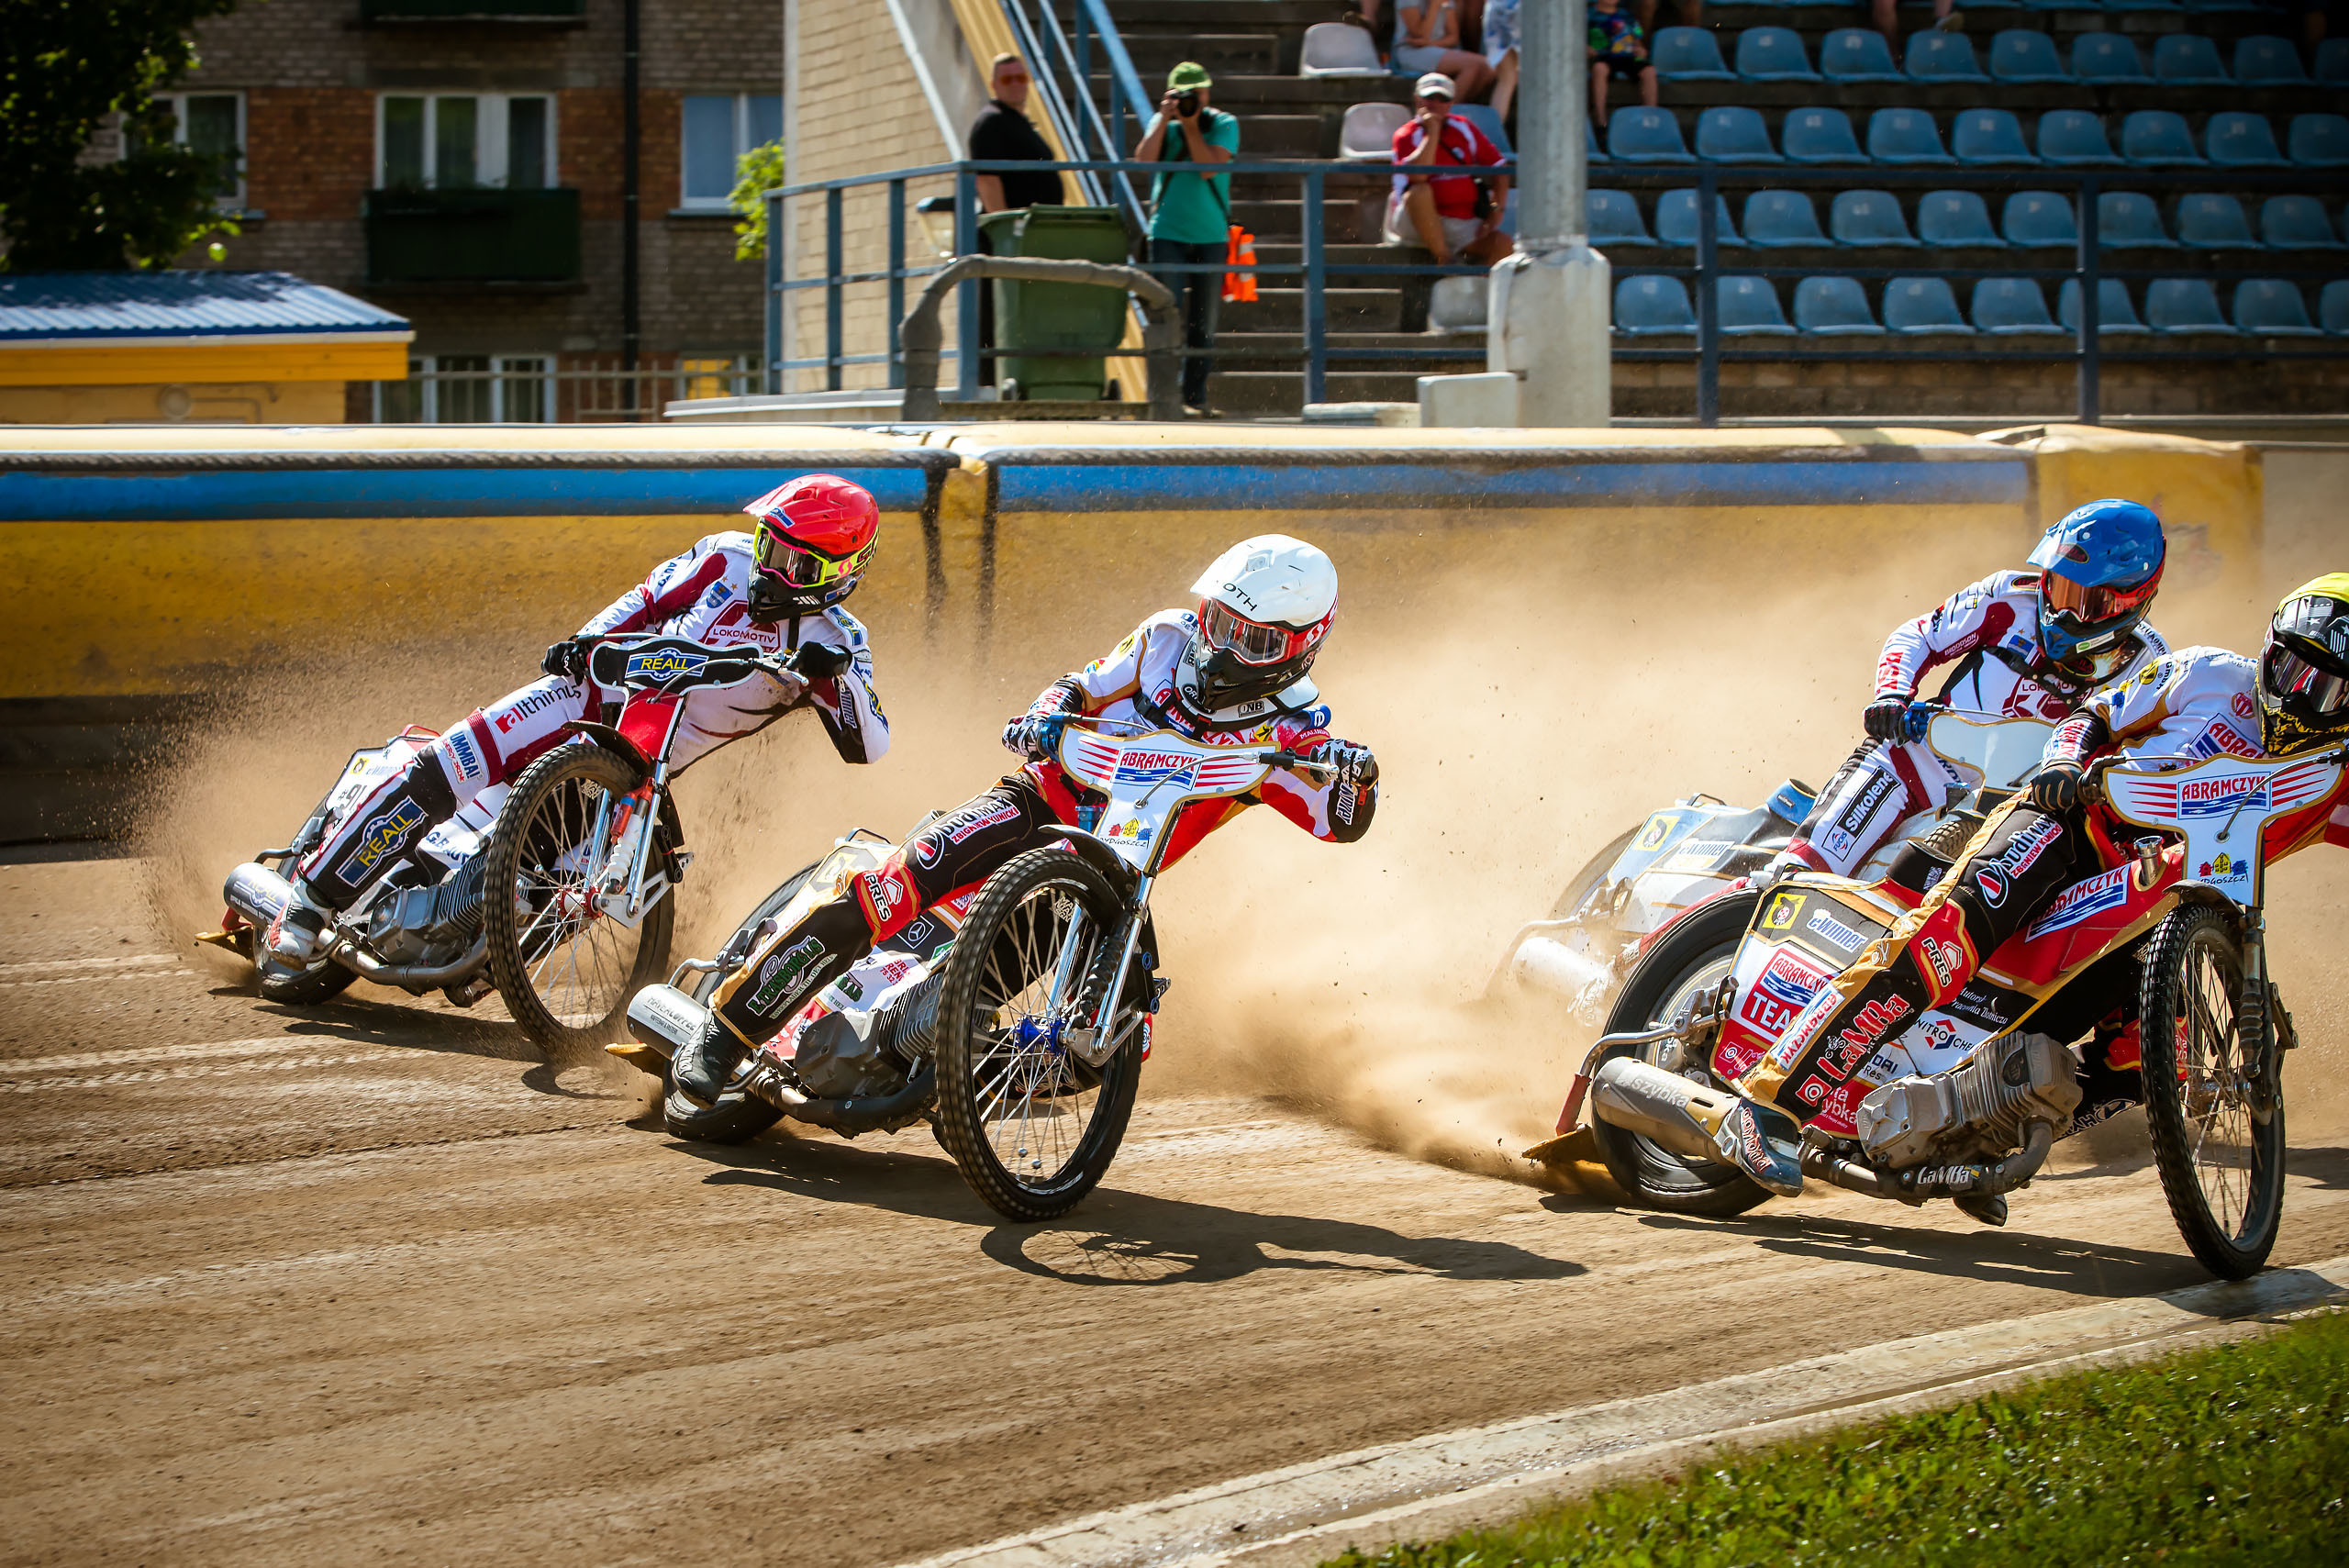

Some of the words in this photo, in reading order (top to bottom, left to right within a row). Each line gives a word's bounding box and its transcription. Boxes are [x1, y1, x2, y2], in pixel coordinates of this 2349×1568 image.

[713, 628, 775, 643] LOKOMOTIV
[640, 658, 688, 671] REALL
[1847, 772, 1893, 835] Silkolene
[2181, 775, 2266, 801] ABRAMCZYK
[359, 815, 413, 866] REALL
[864, 873, 892, 921] PRES
[1922, 937, 1953, 987] PRES
[1753, 991, 1790, 1032] TEA
[1917, 1018, 1949, 1040] NITRO
[1822, 1098, 1857, 1124] ybka
